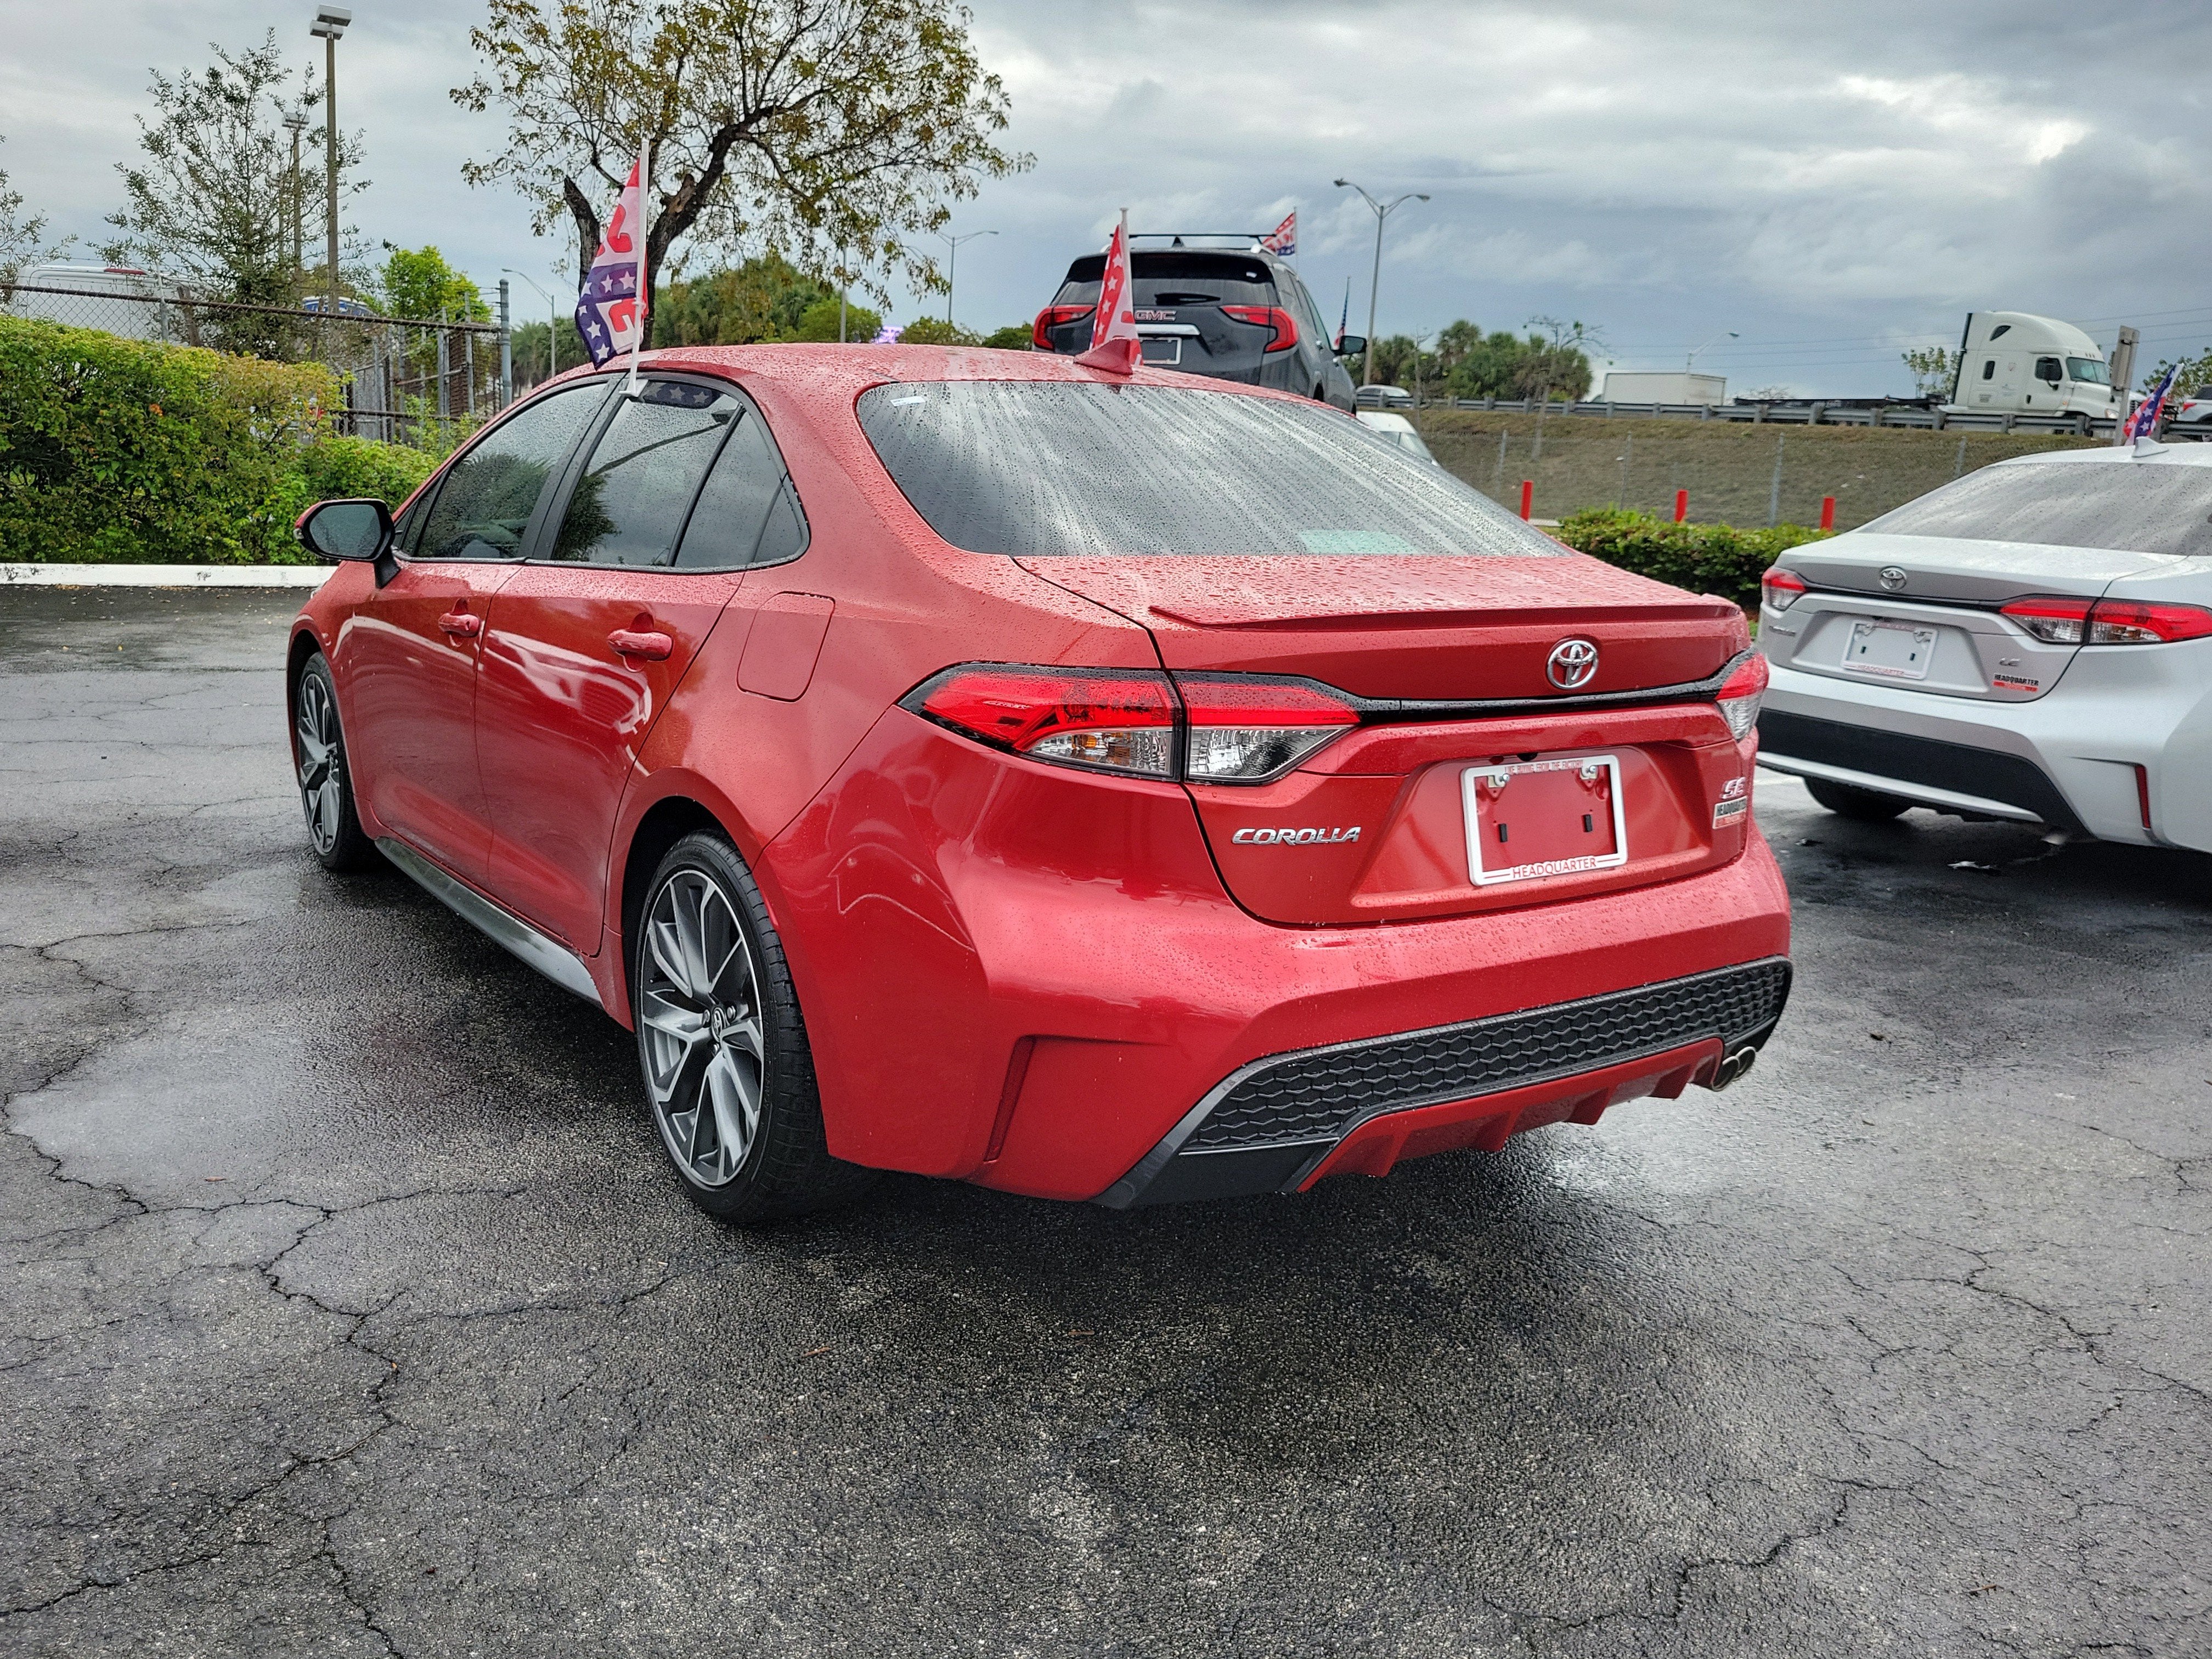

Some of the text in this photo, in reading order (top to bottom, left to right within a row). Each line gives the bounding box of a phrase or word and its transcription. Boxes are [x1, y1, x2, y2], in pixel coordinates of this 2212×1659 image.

[1135, 309, 1176, 321] GMC
[1994, 674, 2039, 686] HEADQUARTER
[1720, 776, 1746, 799] SE
[1232, 826, 1362, 845] COROLLA
[1512, 857, 1597, 878] HEADQUARTER
